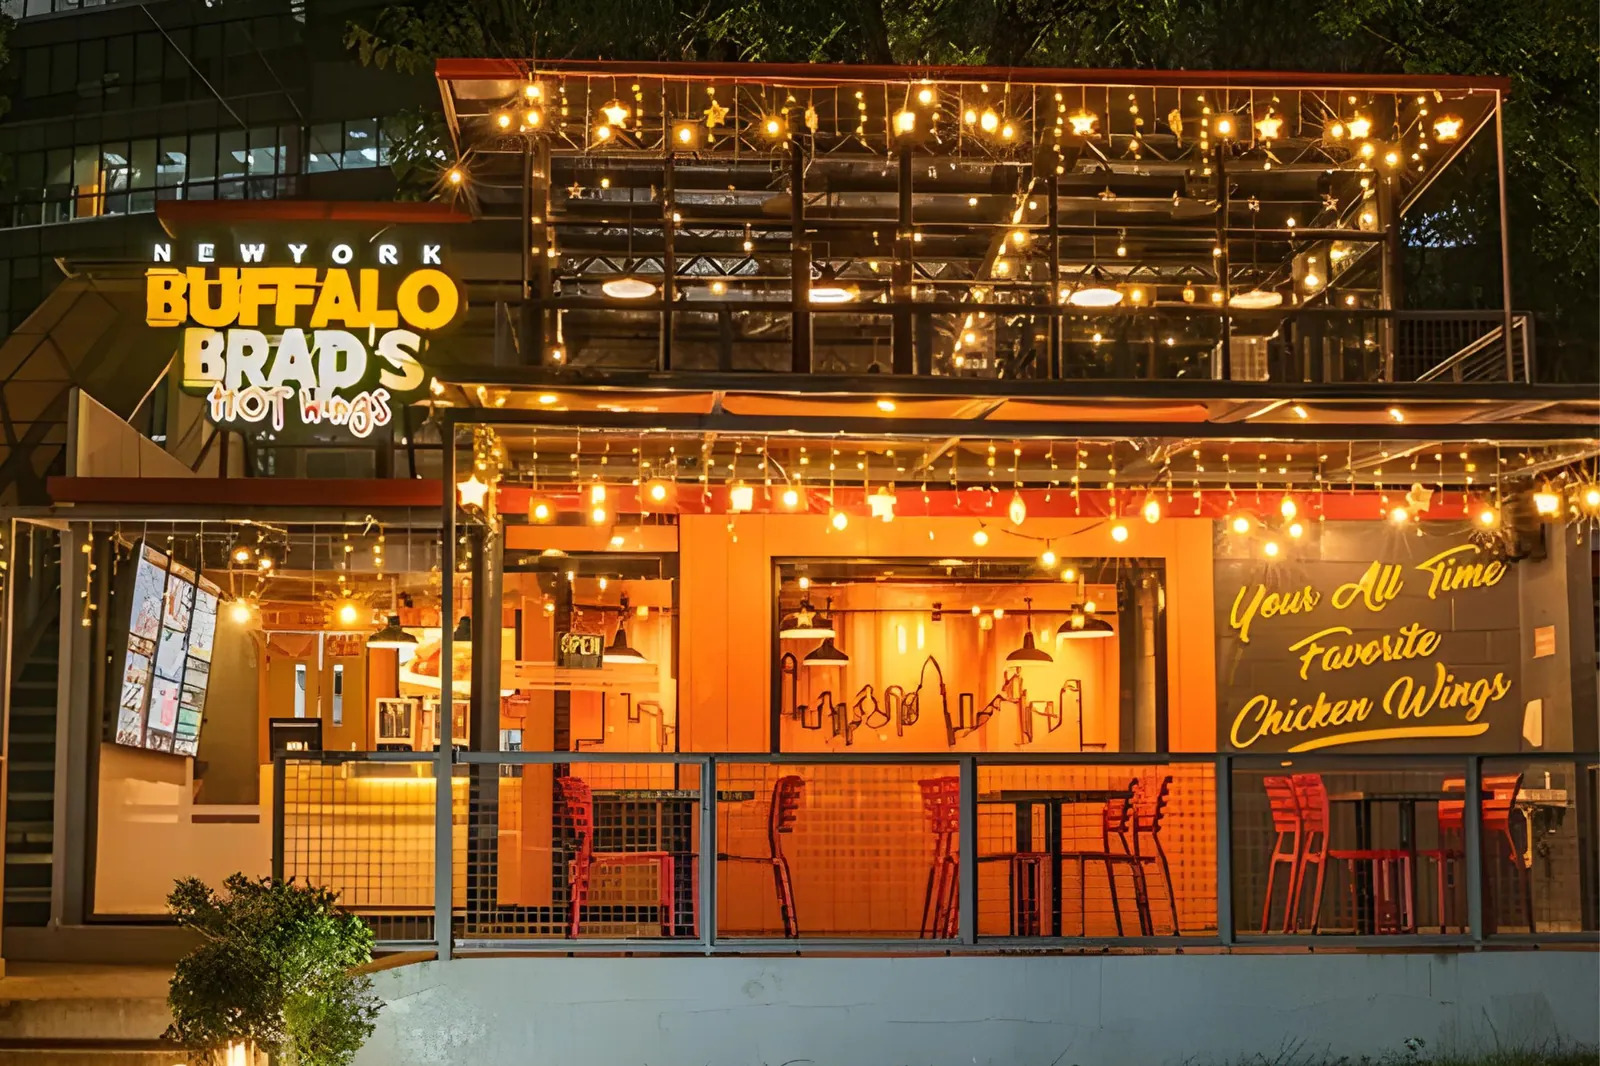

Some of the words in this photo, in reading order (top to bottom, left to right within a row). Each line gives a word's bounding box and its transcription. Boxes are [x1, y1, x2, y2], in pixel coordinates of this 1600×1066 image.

[145, 266, 459, 330] BUFFALO
[183, 322, 425, 392] BRAD'S
[1229, 583, 1321, 643] Your
[1331, 559, 1404, 612] All
[1415, 543, 1507, 600] Time
[1288, 622, 1442, 681] Favorite
[1229, 691, 1374, 749] Chicken
[1382, 661, 1512, 722] Wings
